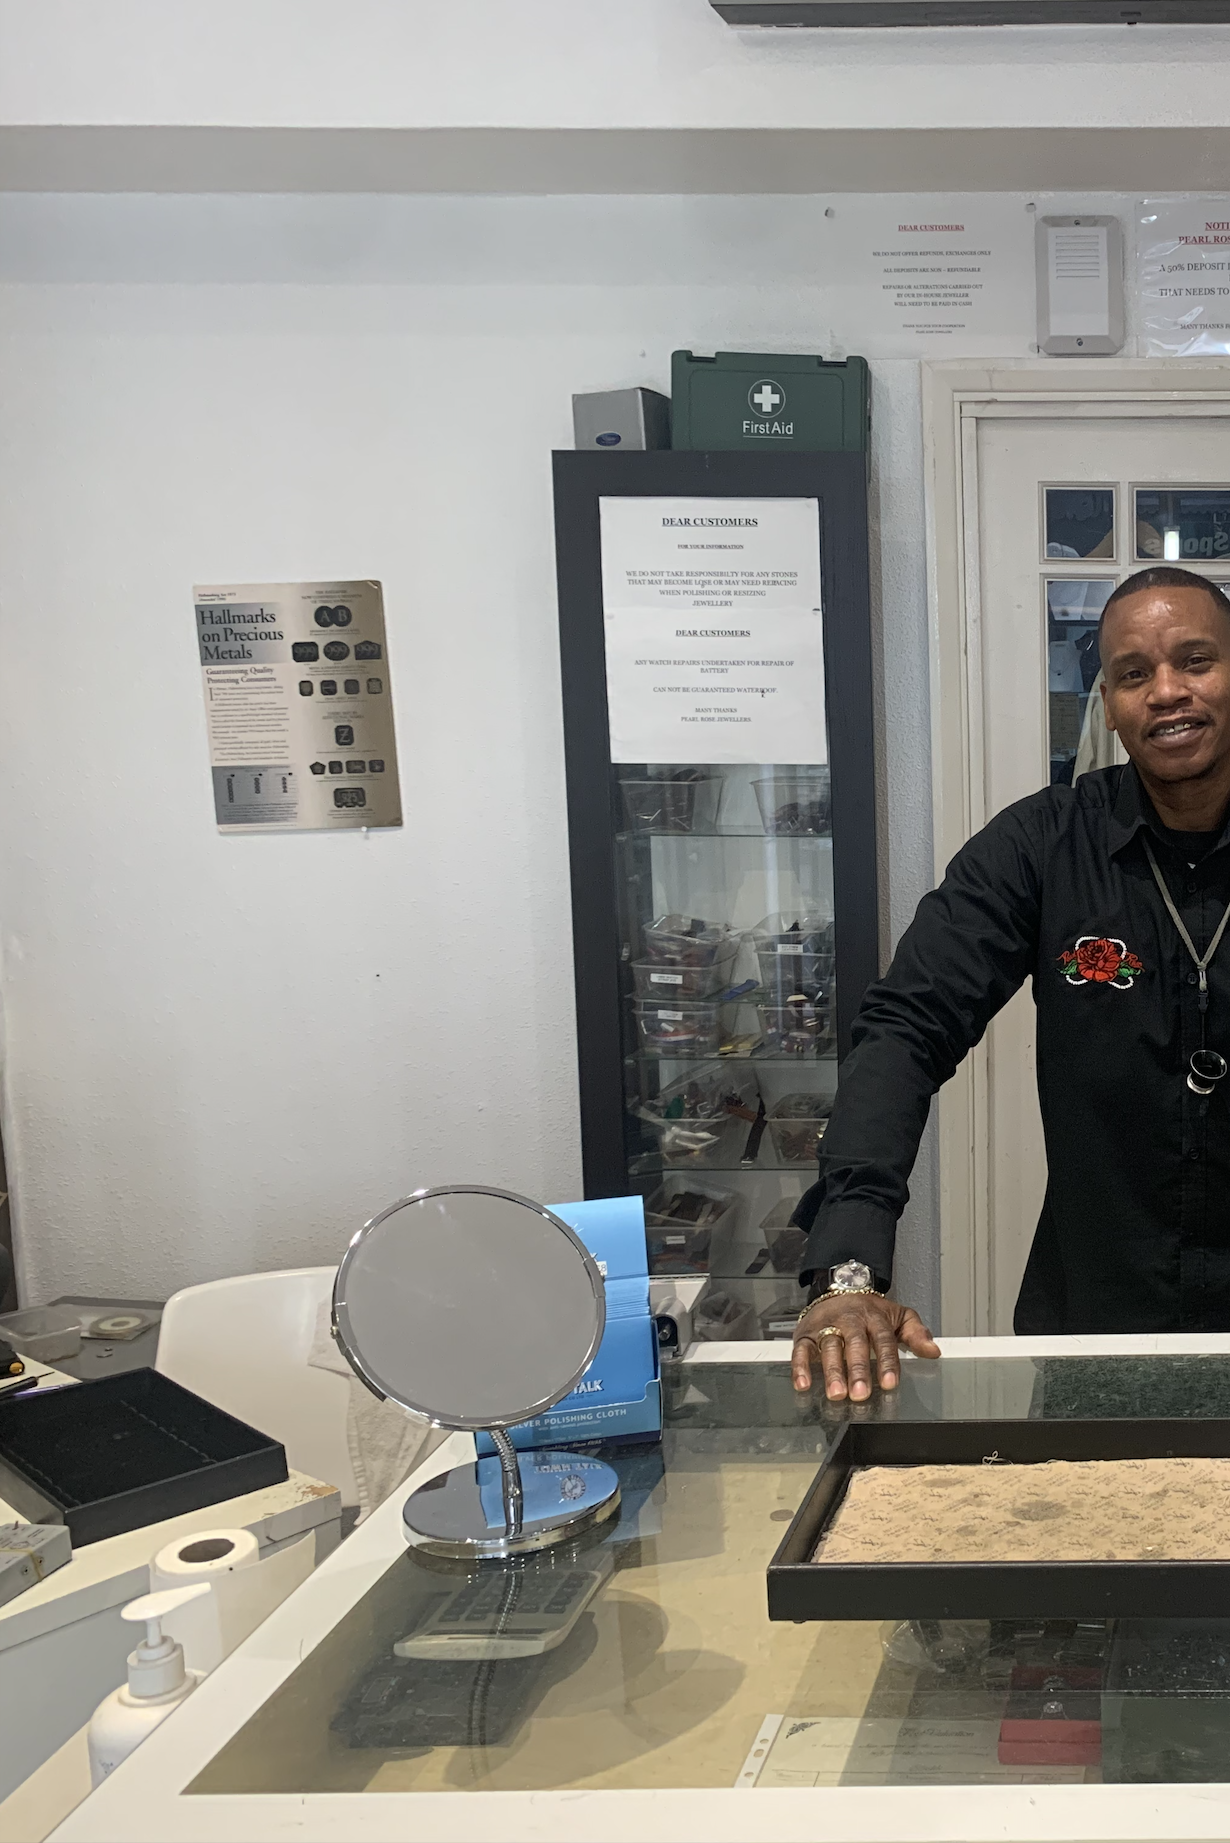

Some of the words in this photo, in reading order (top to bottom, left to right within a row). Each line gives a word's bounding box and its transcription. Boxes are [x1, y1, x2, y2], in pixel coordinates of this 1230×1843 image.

[1179, 236, 1211, 244] PEARL
[1185, 288, 1215, 296] NEEDS
[743, 420, 770, 434] First
[771, 422, 793, 434] Aid
[662, 518, 691, 526] DEAR
[694, 518, 758, 526] CUSTOMERS
[200, 608, 276, 625] Hallmarks
[202, 632, 220, 643] on
[223, 626, 284, 642] Precious
[203, 644, 253, 660] Metals
[250, 667, 274, 675] Quality
[544, 1413, 594, 1425] POLISHING
[596, 1409, 627, 1419] CLOTH
